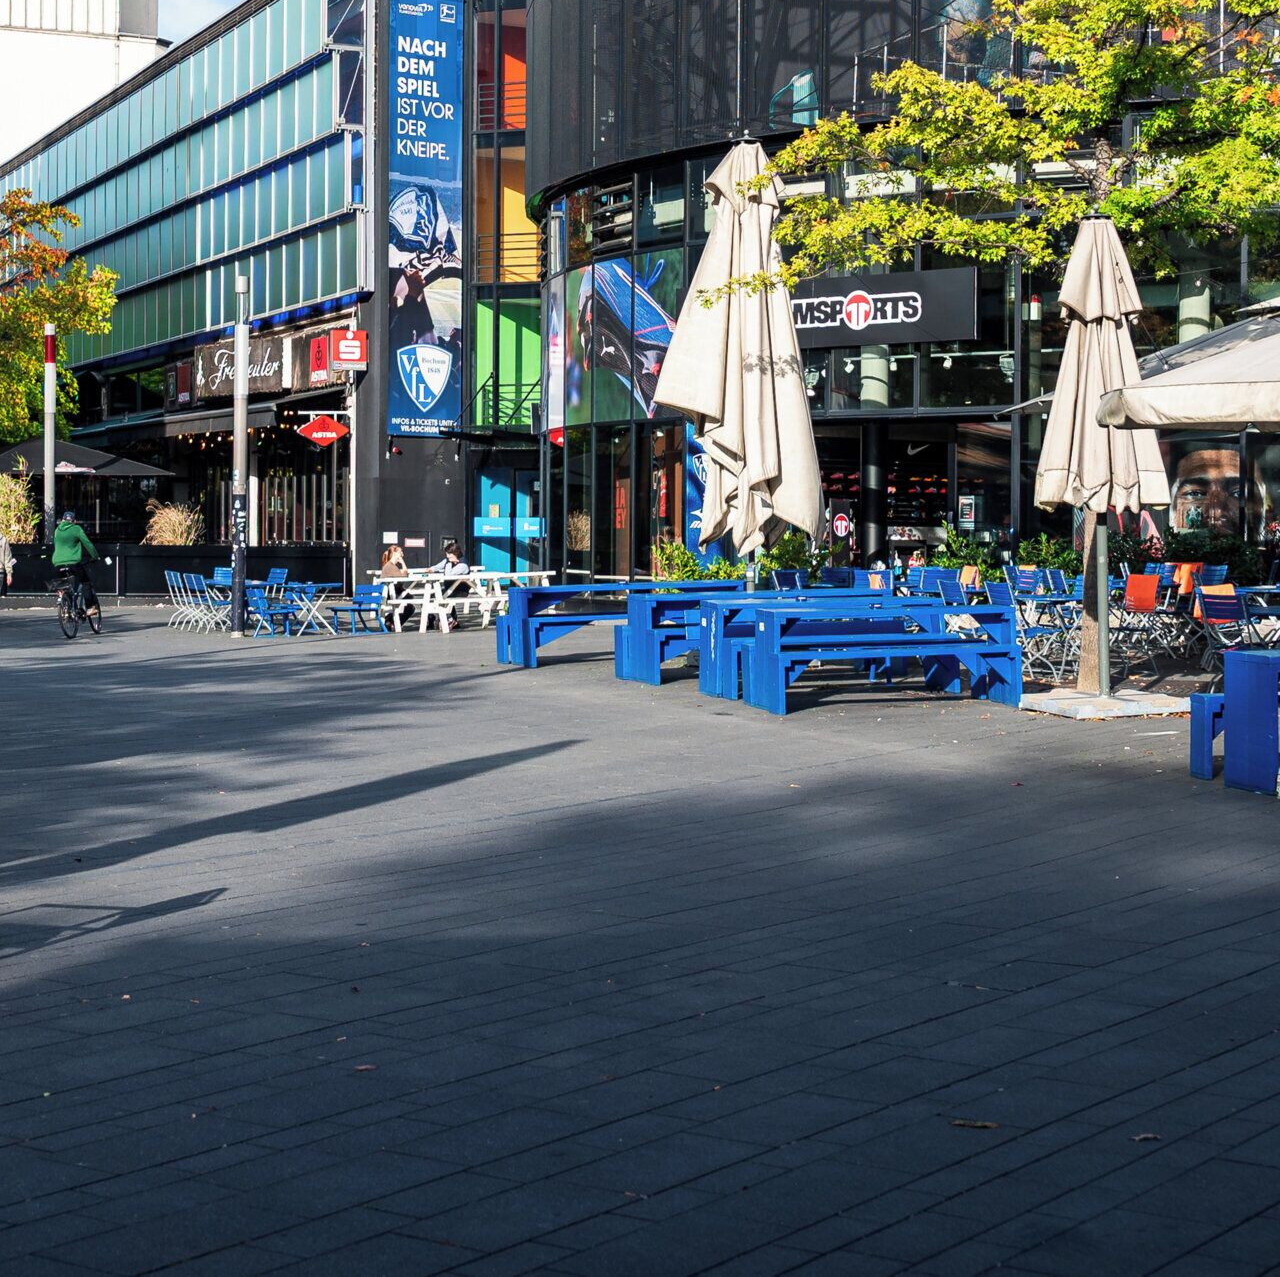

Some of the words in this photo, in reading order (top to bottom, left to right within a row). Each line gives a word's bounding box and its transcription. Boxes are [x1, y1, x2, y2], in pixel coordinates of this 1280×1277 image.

[397, 35, 447, 58] NACH
[397, 56, 435, 77] DEM
[397, 77, 440, 98] SPIEL
[397, 97, 419, 115] IST
[421, 101, 454, 120] VOR
[397, 118, 427, 137] DER
[397, 138, 450, 161] KNEIPE.
[209, 347, 281, 390] Freeuter
[422, 357, 446, 365] Bochum
[391, 417, 410, 425] INFOS
[416, 419, 438, 427] TICKETS
[311, 431, 338, 439] ASTRA
